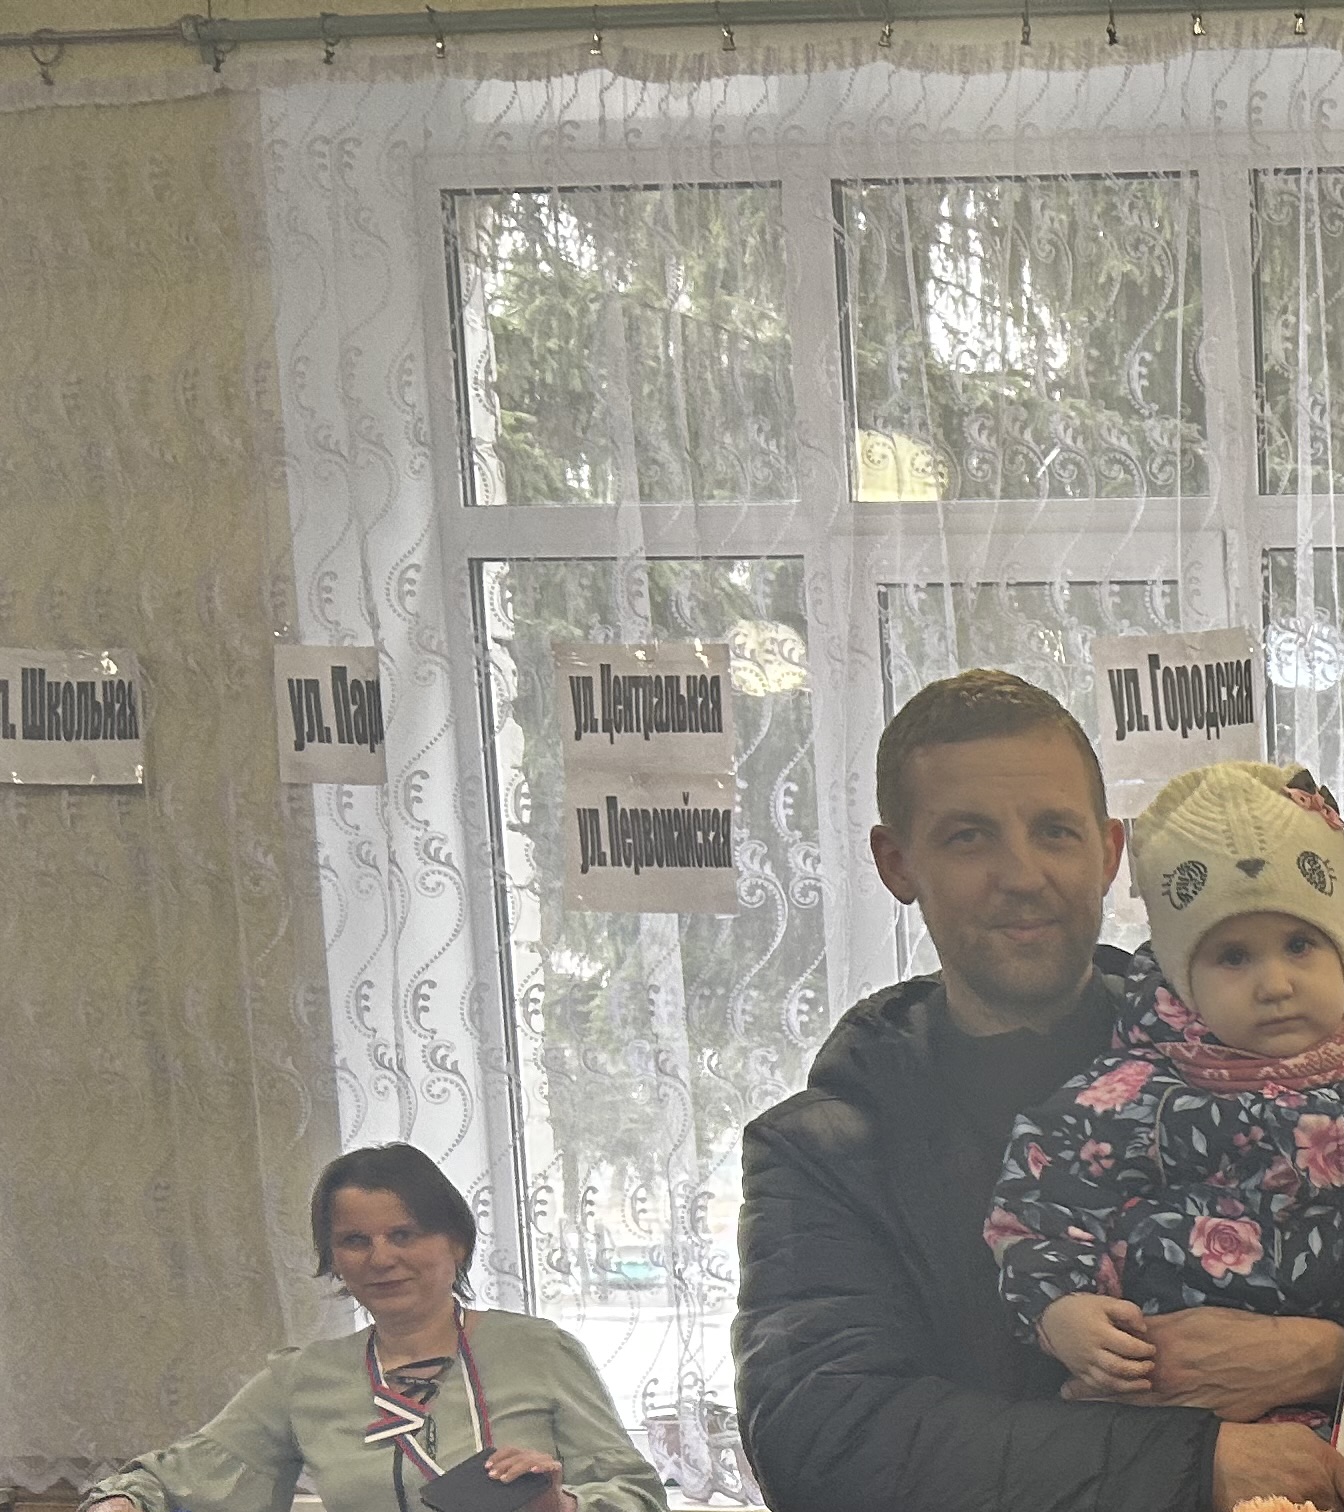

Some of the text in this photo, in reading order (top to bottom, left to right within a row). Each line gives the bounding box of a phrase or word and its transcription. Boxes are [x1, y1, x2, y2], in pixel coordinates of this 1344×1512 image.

[287, 678, 332, 752] ул.
[568, 663, 724, 745] ул. Центральная
[1107, 653, 1254, 742] ул. Городская
[576, 791, 733, 876] ул. Первомайская
